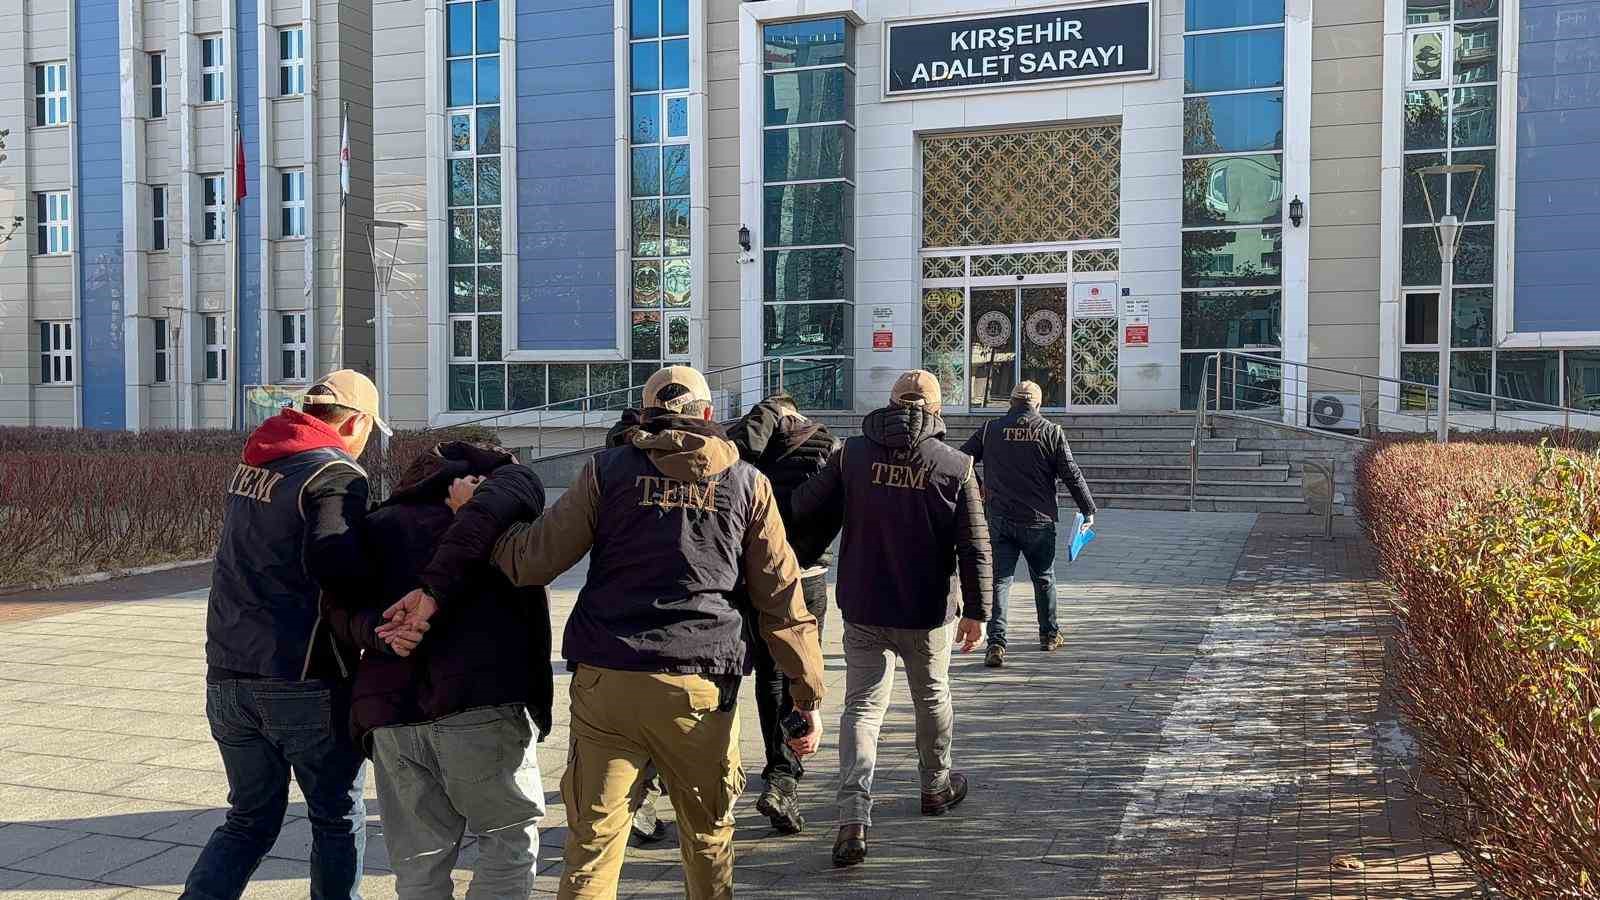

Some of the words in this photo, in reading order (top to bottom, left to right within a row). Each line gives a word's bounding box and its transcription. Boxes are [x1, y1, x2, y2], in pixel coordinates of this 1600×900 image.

[950, 17, 1083, 52] KIRŞEHİR
[911, 54, 1014, 83] ADALET
[1019, 44, 1124, 74] SARAYI
[1003, 427, 1042, 442] TEM
[228, 463, 285, 503] TEM
[634, 475, 720, 512] TEM
[871, 462, 929, 490] TEM
